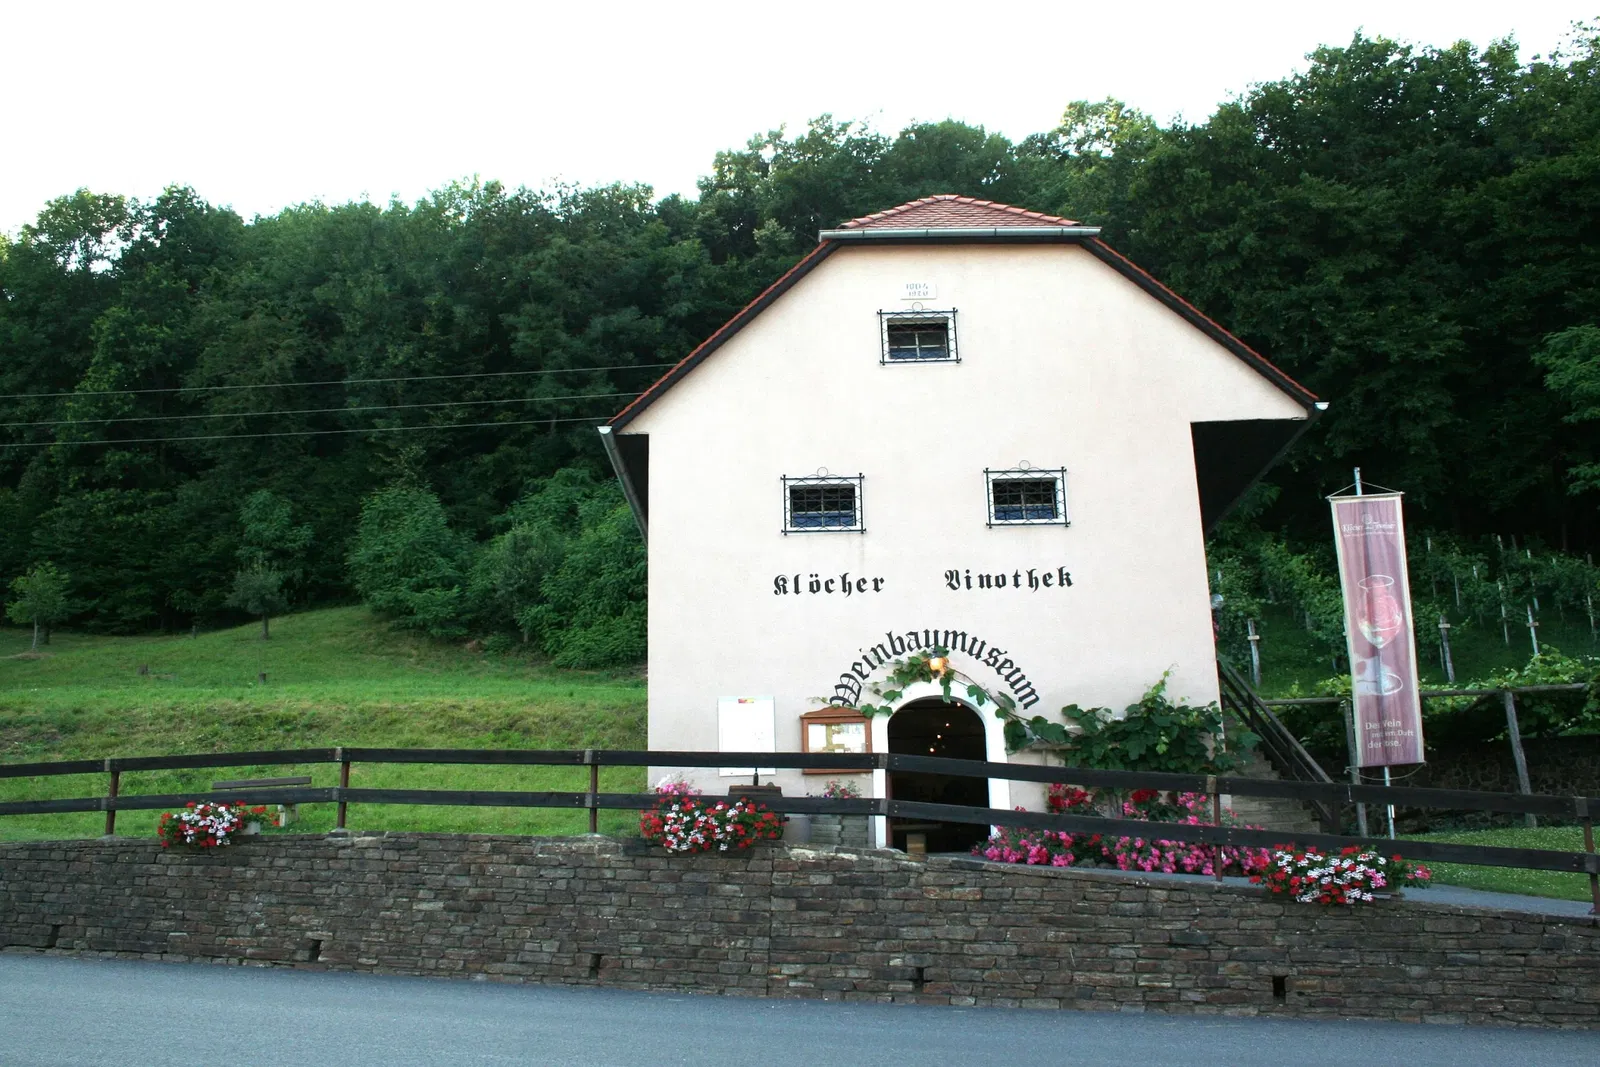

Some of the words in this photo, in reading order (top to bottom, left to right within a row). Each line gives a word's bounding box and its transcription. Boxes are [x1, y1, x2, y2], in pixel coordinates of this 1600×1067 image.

[773, 572, 885, 598] Klöcher
[944, 566, 1074, 593] Vinothek
[829, 628, 1040, 710] Weinbaumuseum
[1383, 740, 1402, 748] ose.
